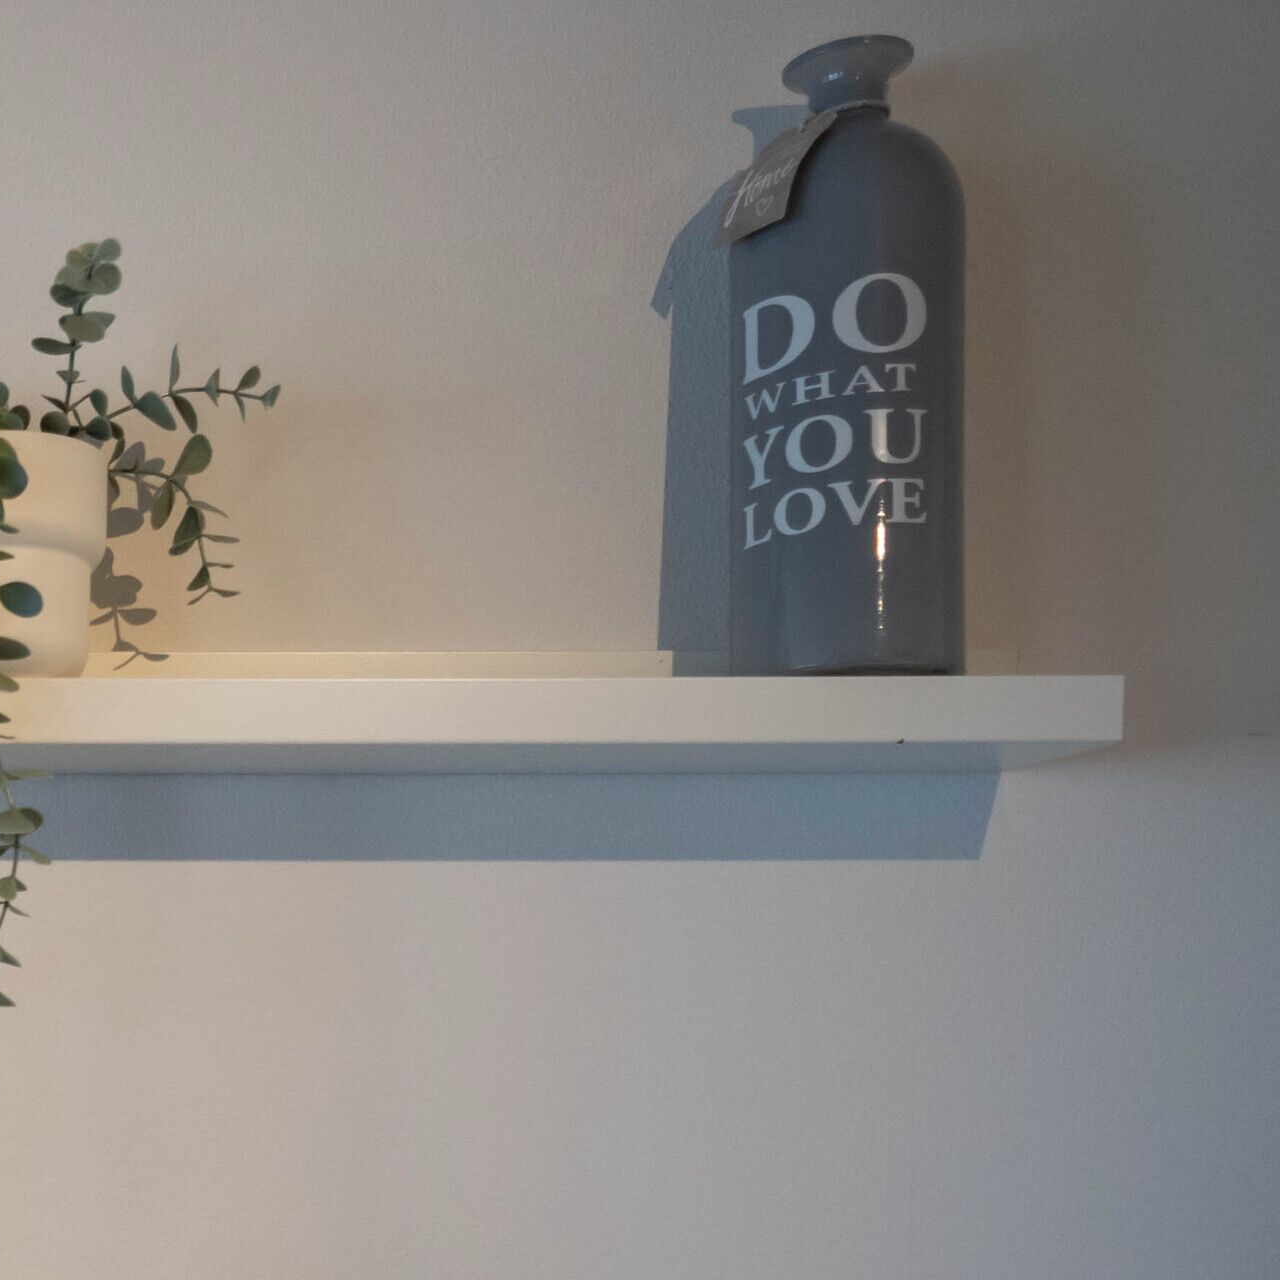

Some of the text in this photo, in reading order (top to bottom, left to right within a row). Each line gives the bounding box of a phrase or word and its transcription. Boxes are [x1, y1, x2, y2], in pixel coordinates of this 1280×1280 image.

[743, 272, 927, 386] DO
[744, 363, 917, 420] WHAT
[743, 408, 928, 491] YOU
[743, 478, 928, 550] LOVE
